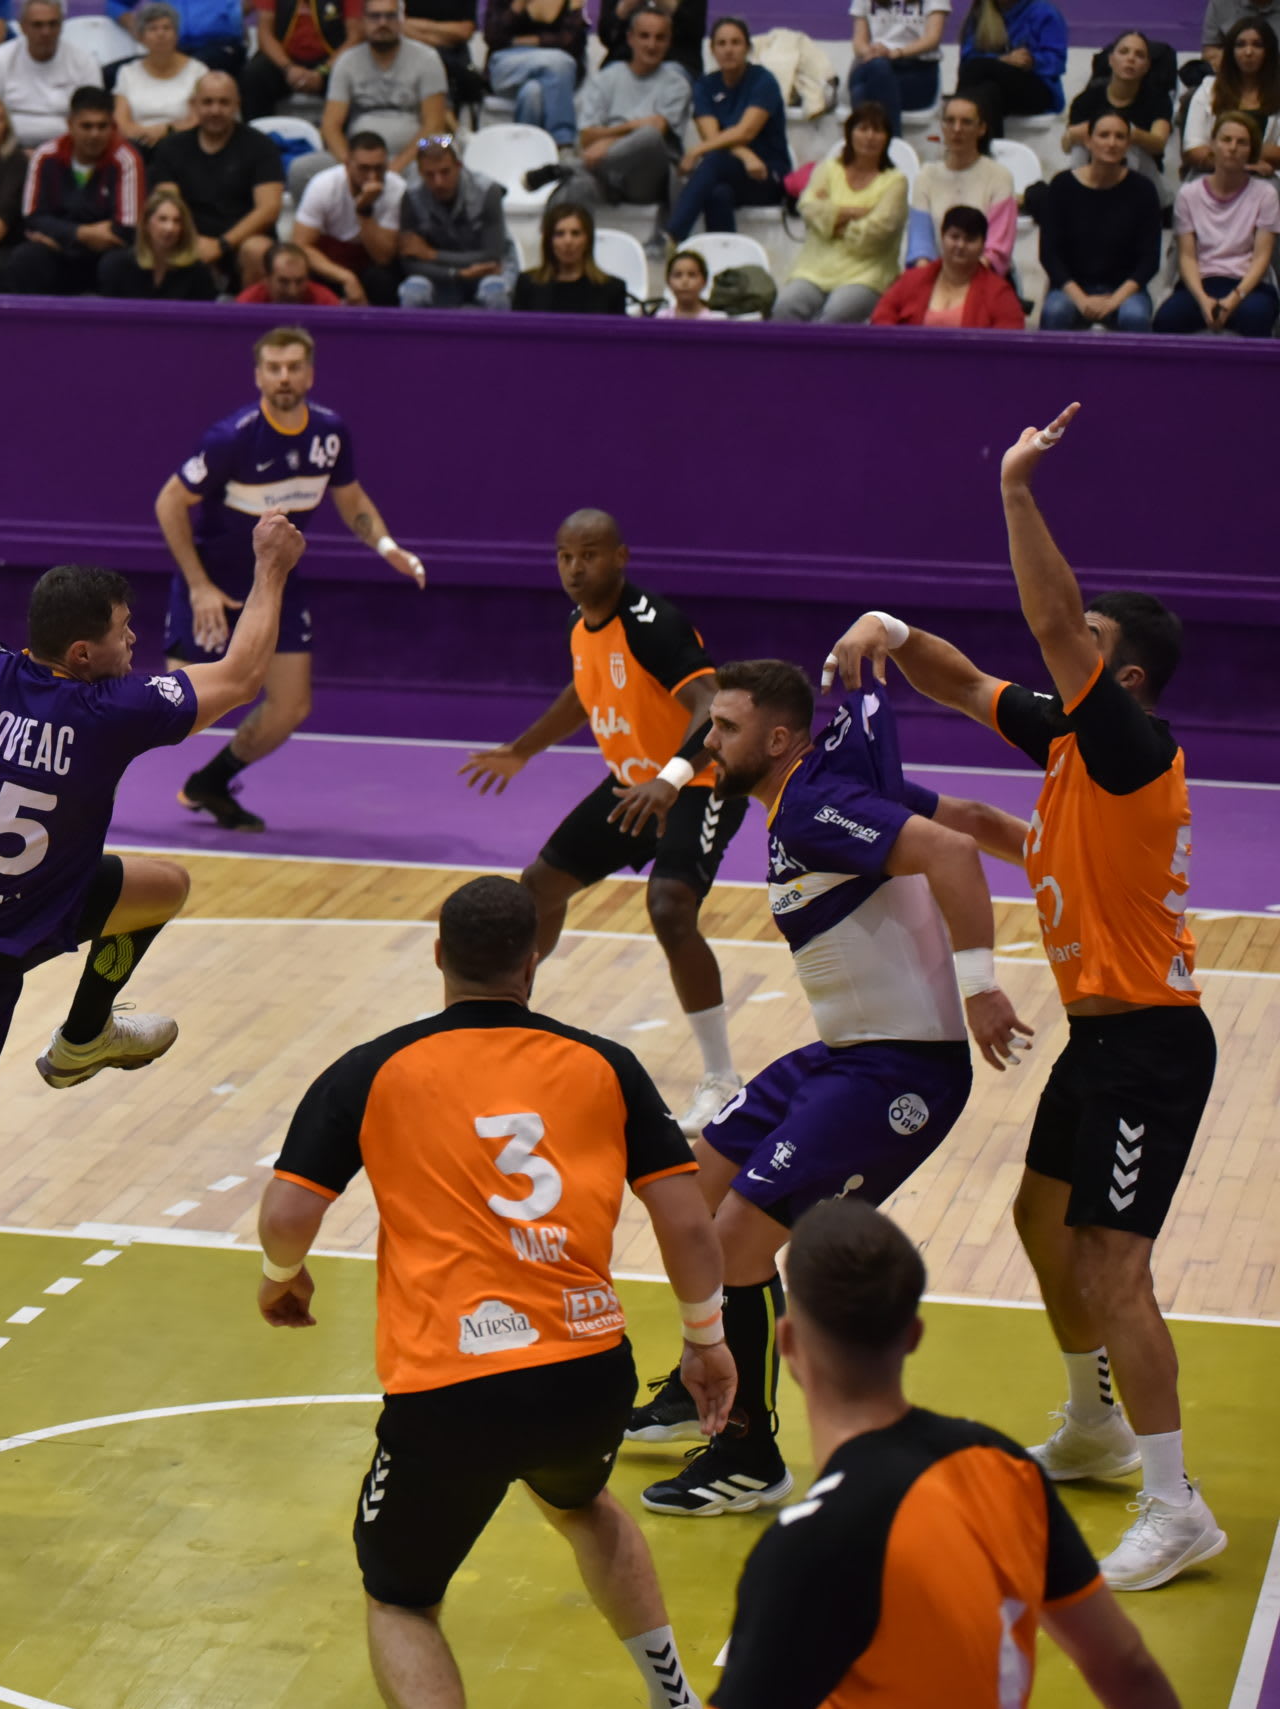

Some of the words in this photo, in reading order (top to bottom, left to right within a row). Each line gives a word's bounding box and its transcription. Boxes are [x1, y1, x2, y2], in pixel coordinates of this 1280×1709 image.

[309, 433, 340, 468] 49
[818, 807, 881, 840] SCHRACK
[890, 1107, 919, 1132] One
[897, 1096, 926, 1122] Gym
[474, 1112, 563, 1222] 3
[509, 1226, 570, 1262] NAGY
[463, 1313, 528, 1341] Artesia
